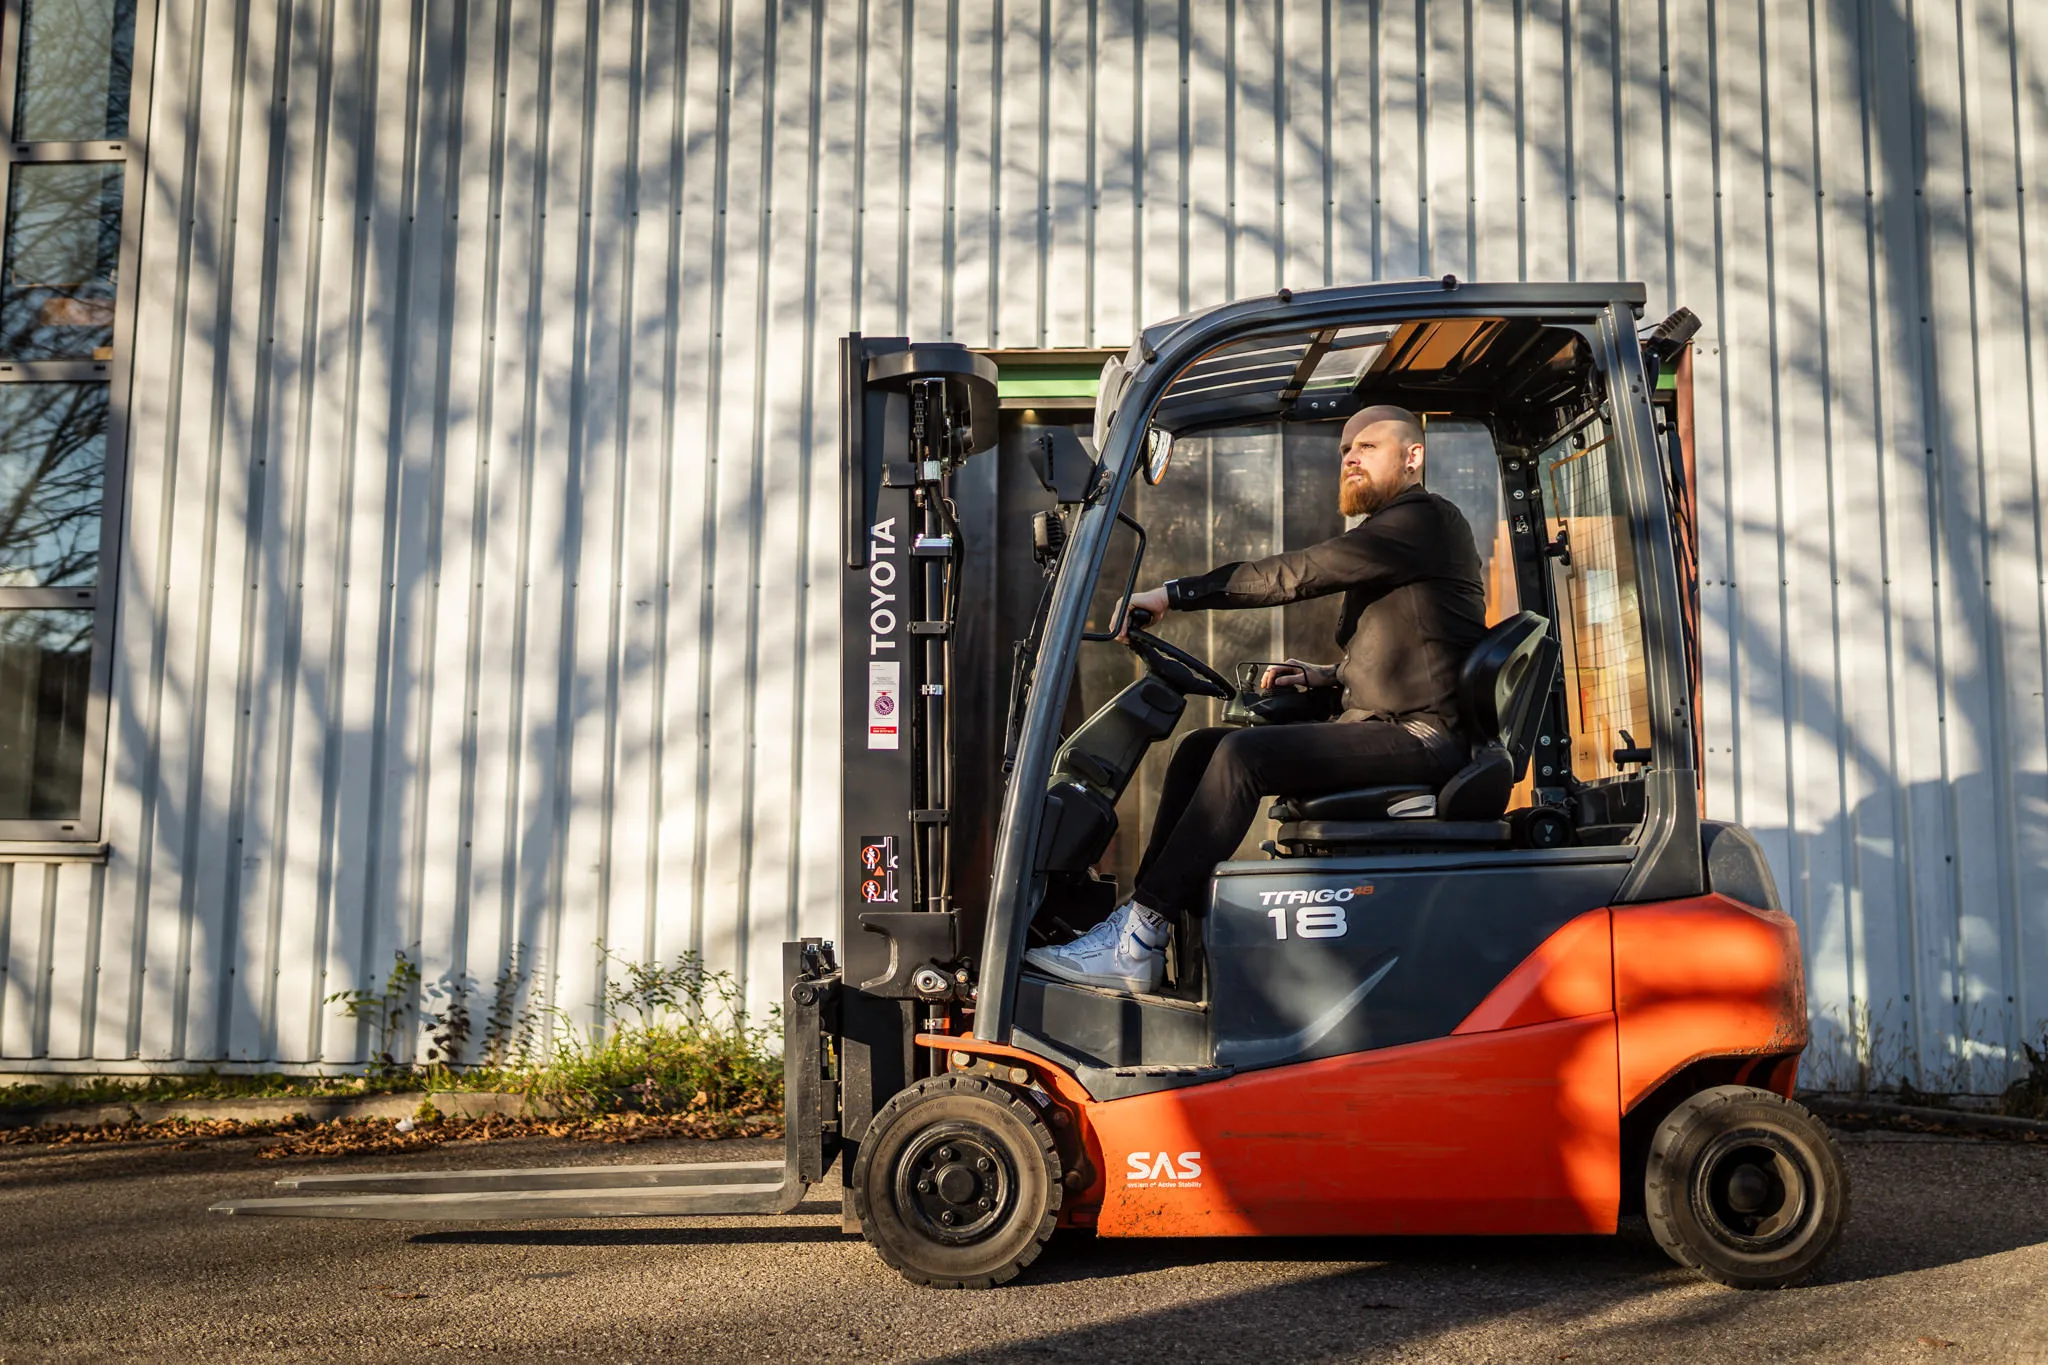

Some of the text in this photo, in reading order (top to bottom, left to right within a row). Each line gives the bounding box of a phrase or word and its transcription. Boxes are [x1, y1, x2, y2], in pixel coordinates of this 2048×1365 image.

[870, 517, 896, 656] TOYOTA
[1259, 888, 1354, 905] TRAIGO
[1267, 906, 1348, 940] 18
[1126, 1151, 1202, 1180] SAS
